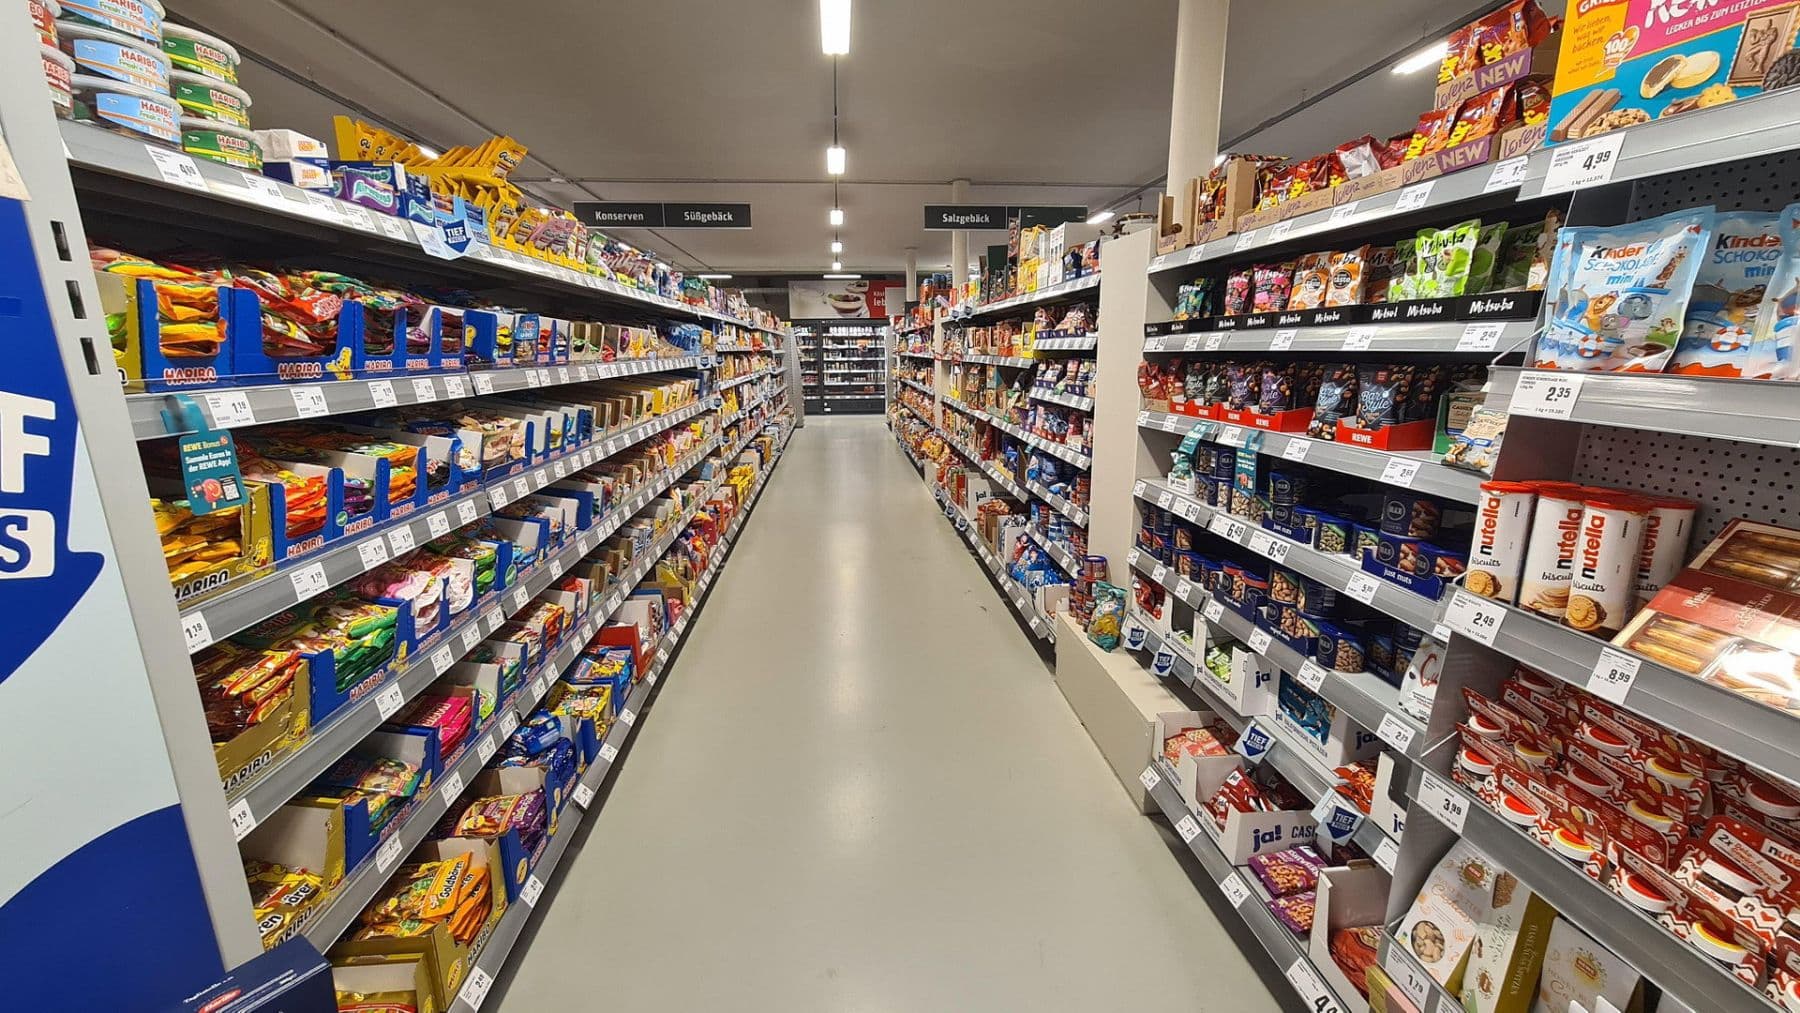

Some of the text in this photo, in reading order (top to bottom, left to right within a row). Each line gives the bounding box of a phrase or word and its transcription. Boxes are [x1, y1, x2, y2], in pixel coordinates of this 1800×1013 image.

[108, 0, 143, 14] ARIBO
[1695, 14, 1710, 27] BIS
[1711, 8, 1729, 22] ZUM
[121, 49, 158, 69] HARIBO
[195, 44, 228, 62] HARIBO
[1481, 56, 1525, 88] NEW
[210, 90, 242, 108] HARIBO
[1437, 78, 1474, 109] Lorenz
[141, 101, 173, 118] HARIBO
[217, 135, 249, 151] HARIBO
[1504, 126, 1546, 158] Loren
[1441, 142, 1485, 170] NEW
[1583, 151, 1611, 170] 4.99
[1402, 157, 1436, 182] Lorenz
[595, 210, 644, 221] Konserven
[683, 210, 734, 223] Süßgebäck
[942, 213, 990, 225] Salzgebäck
[446, 227, 465, 238] TIEF
[1716, 233, 1782, 249] Kinde
[1713, 248, 1784, 264] SCHOKO
[1744, 263, 1777, 278] min
[278, 361, 323, 381] HARIBO
[365, 359, 394, 373] HARIBO
[406, 358, 429, 370] HARIBO
[164, 367, 217, 385] HARIBO
[1360, 390, 1383, 403] Bar
[1545, 386, 1572, 402] 2.35
[1362, 398, 1391, 413] Style
[1352, 432, 1373, 445] REWE
[389, 502, 416, 520] HARIBO
[1185, 503, 1199, 518] 6.49
[344, 516, 374, 536] HARIBO
[1227, 523, 1244, 539] 6.49
[1479, 496, 1502, 556] nutella
[287, 536, 325, 558] HARIBO
[1556, 507, 1583, 570] nutella
[1580, 514, 1606, 580] nutella
[1268, 541, 1289, 558] 6.49
[1471, 555, 1502, 568] biscuits
[1383, 567, 1413, 585] just nuts
[1572, 580, 1608, 593] biscuits
[1472, 611, 1496, 628] 2.49
[185, 621, 203, 639] 1.19
[1609, 668, 1632, 684] 8.99
[349, 670, 385, 701] HARIBO
[1250, 733, 1270, 745] TIEF
[1443, 798, 1462, 816] 3.99
[1334, 813, 1355, 826] TIEF
[1252, 824, 1318, 853] ja! CAS
[1717, 832, 1735, 848] 2x
[439, 861, 463, 899] Goldbären
